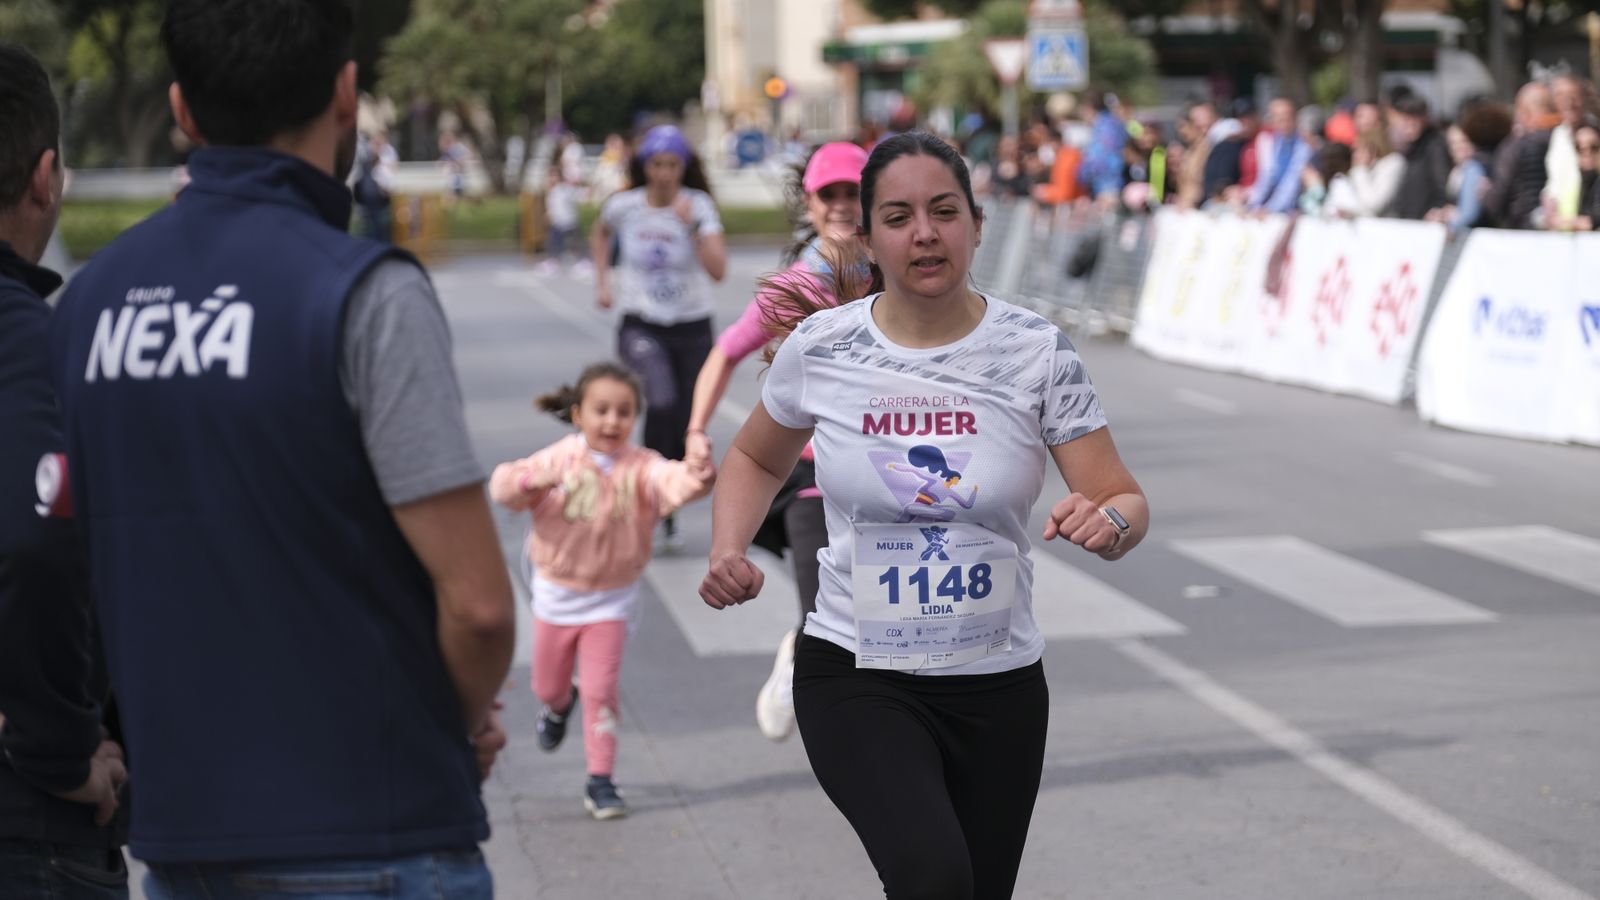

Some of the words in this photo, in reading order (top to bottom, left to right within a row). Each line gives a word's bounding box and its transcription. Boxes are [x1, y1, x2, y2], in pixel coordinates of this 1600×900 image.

[126, 286, 175, 303] GRUPO
[869, 396, 930, 408] CARRERA
[932, 396, 949, 407] DE
[953, 395, 970, 407] LA
[862, 411, 978, 436] MUJER
[876, 541, 914, 551] MUJER
[879, 563, 992, 604] 1148
[921, 605, 953, 615] LIDIA
[886, 627, 904, 637] CDX
